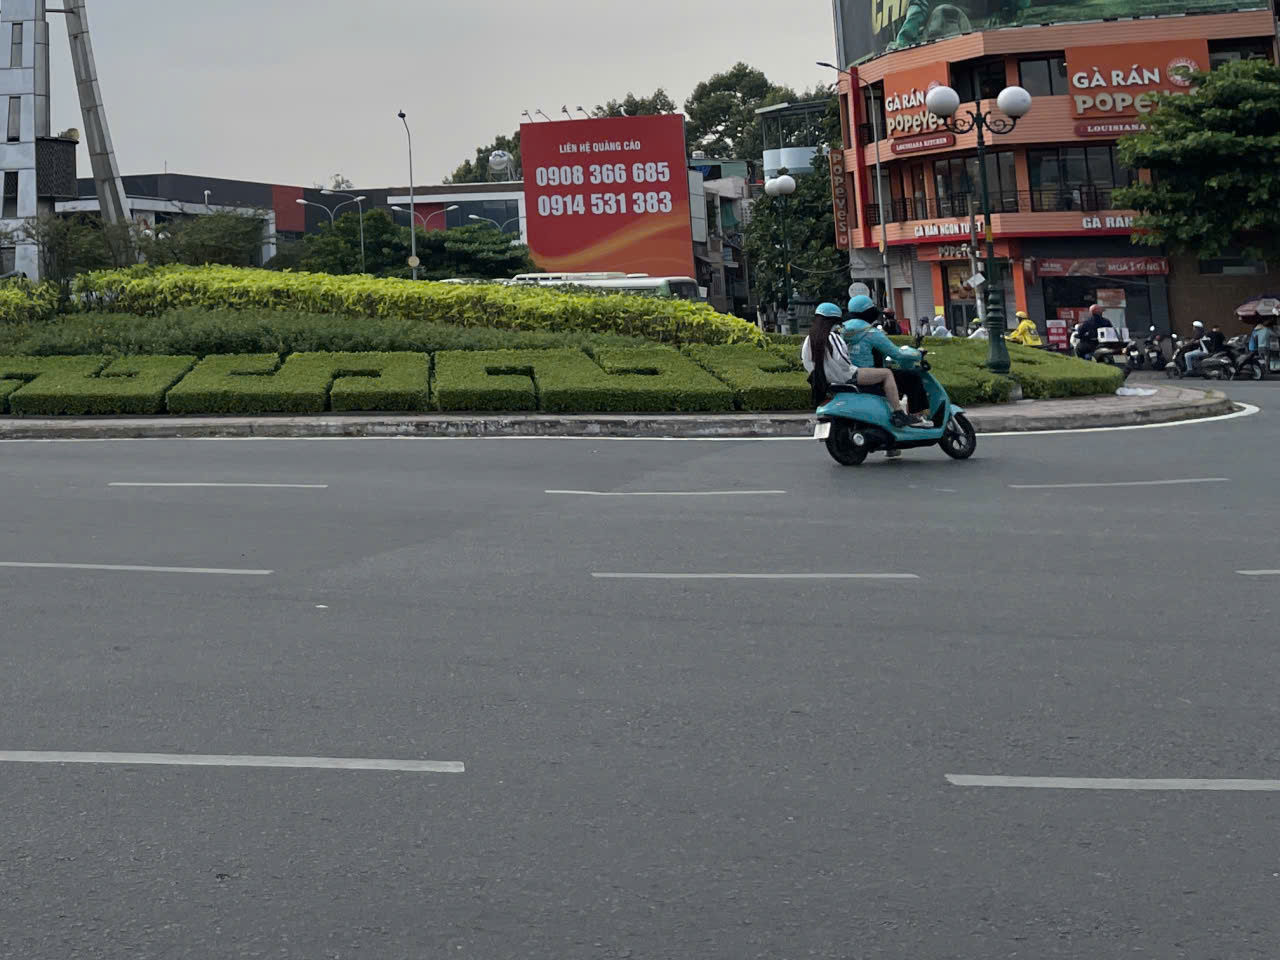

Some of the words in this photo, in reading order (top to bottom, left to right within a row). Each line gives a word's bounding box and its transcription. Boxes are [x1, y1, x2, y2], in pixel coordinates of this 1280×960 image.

[1072, 66, 1107, 89] GÀ
[1111, 64, 1160, 86] RÁN
[886, 92, 901, 111] GÀ
[902, 88, 924, 109] RÁN
[1087, 124, 1147, 132] LOUISIANA
[559, 143, 577, 153] LIÊN
[579, 142, 590, 154] HỆ
[593, 140, 621, 152] QUẢNG
[623, 139, 641, 151] CÁO
[536, 165, 584, 186] 0908
[589, 163, 627, 184] 366
[632, 162, 670, 183] 685
[537, 194, 585, 216] 0914
[590, 192, 627, 214] 531
[632, 191, 672, 214] 383
[1108, 263, 1128, 271] MUA
